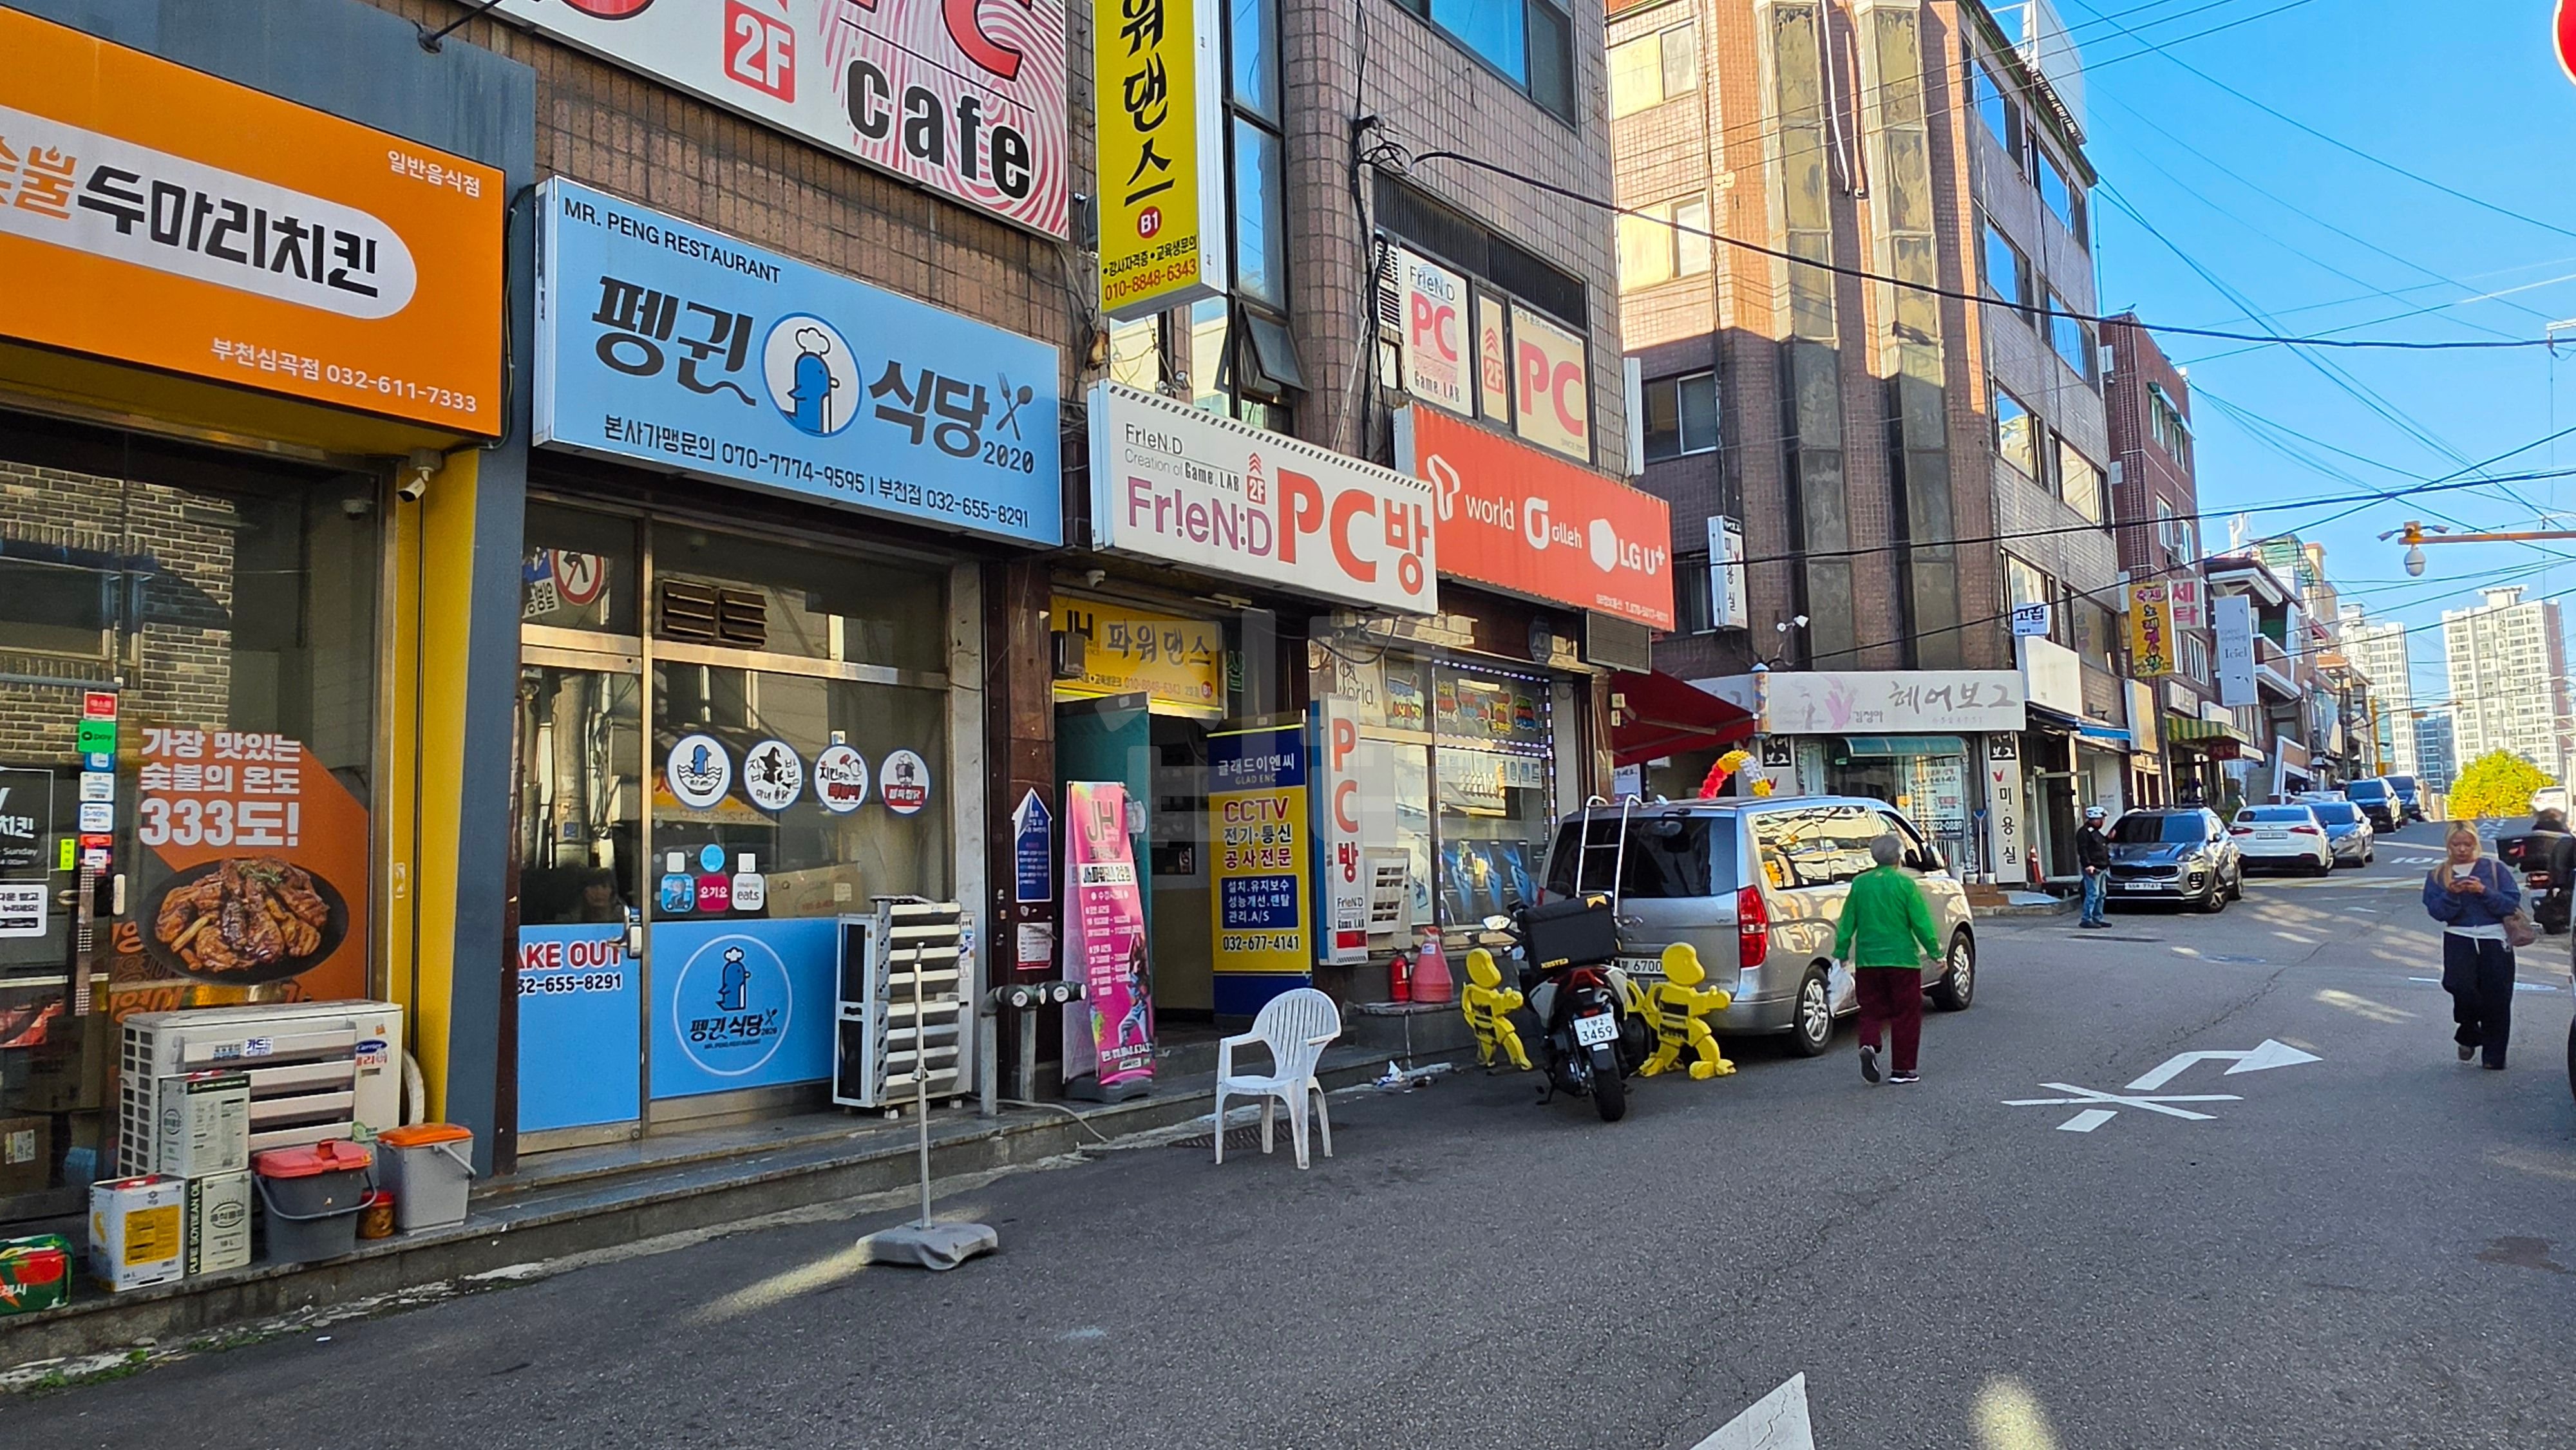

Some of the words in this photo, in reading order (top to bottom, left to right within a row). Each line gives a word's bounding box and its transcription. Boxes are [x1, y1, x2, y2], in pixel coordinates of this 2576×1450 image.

[734, 13, 791, 90] 2F
[847, 59, 1032, 200] cafe
[387, 149, 481, 198] 일반음식점
[1141, 211, 1159, 234] B1
[564, 197, 602, 227] MR.
[607, 215, 659, 245] PENG
[664, 231, 781, 284] RESTAURANT
[1104, 258, 1197, 301] 010-8848-6343
[1410, 290, 1458, 362] PC
[211, 338, 321, 381] 부천심곡점
[327, 364, 477, 413] 032-611-7333
[591, 276, 757, 407] 펭귄
[867, 359, 991, 459] 식당
[983, 440, 1034, 474] 2020
[1485, 358, 1502, 390] 2F
[1519, 338, 1584, 438] PC
[603, 413, 715, 462] 본사가맹문의
[722, 443, 866, 494] 070-7774-9595
[878, 476, 922, 507] 부천점
[926, 490, 1030, 530] 032-655-8291
[1125, 448, 1171, 473] Creation
[1173, 462, 1184, 476] of
[1248, 478, 1265, 503] 2F
[1277, 466, 1430, 596] PC방
[1464, 494, 1515, 531] world
[1551, 522, 1582, 549] olleh
[1619, 538, 1641, 571] LG
[1107, 617, 1212, 666] 파워댄스
[1888, 679, 2018, 715] 헤어보그
[141, 728, 203, 759] 가장
[213, 732, 301, 762] 맛있는
[140, 763, 233, 793] 숯불의
[243, 766, 301, 795] 온도
[1217, 752, 1296, 777] 글래드이엔씨
[1235, 775, 1257, 786] GLAD
[1259, 773, 1277, 783] ENC
[138, 798, 299, 847] 333도!
[1224, 796, 1289, 824] CCTV
[3, 847, 39, 857] Sunday
[699, 885, 729, 899] 요기요
[737, 888, 760, 901] eats
[570, 941, 621, 967] OUT
[1222, 935, 1300, 952] 032-677-4141
[1633, 960, 1663, 972] 6700
[728, 1014, 764, 1037] 식당
[1581, 1025, 1613, 1042] 3459
[357, 1042, 384, 1052] Carrier
[191, 1178, 202, 1197] OIL
[189, 1199, 200, 1248] SOYBEAN
[188, 1250, 198, 1275] PURE
